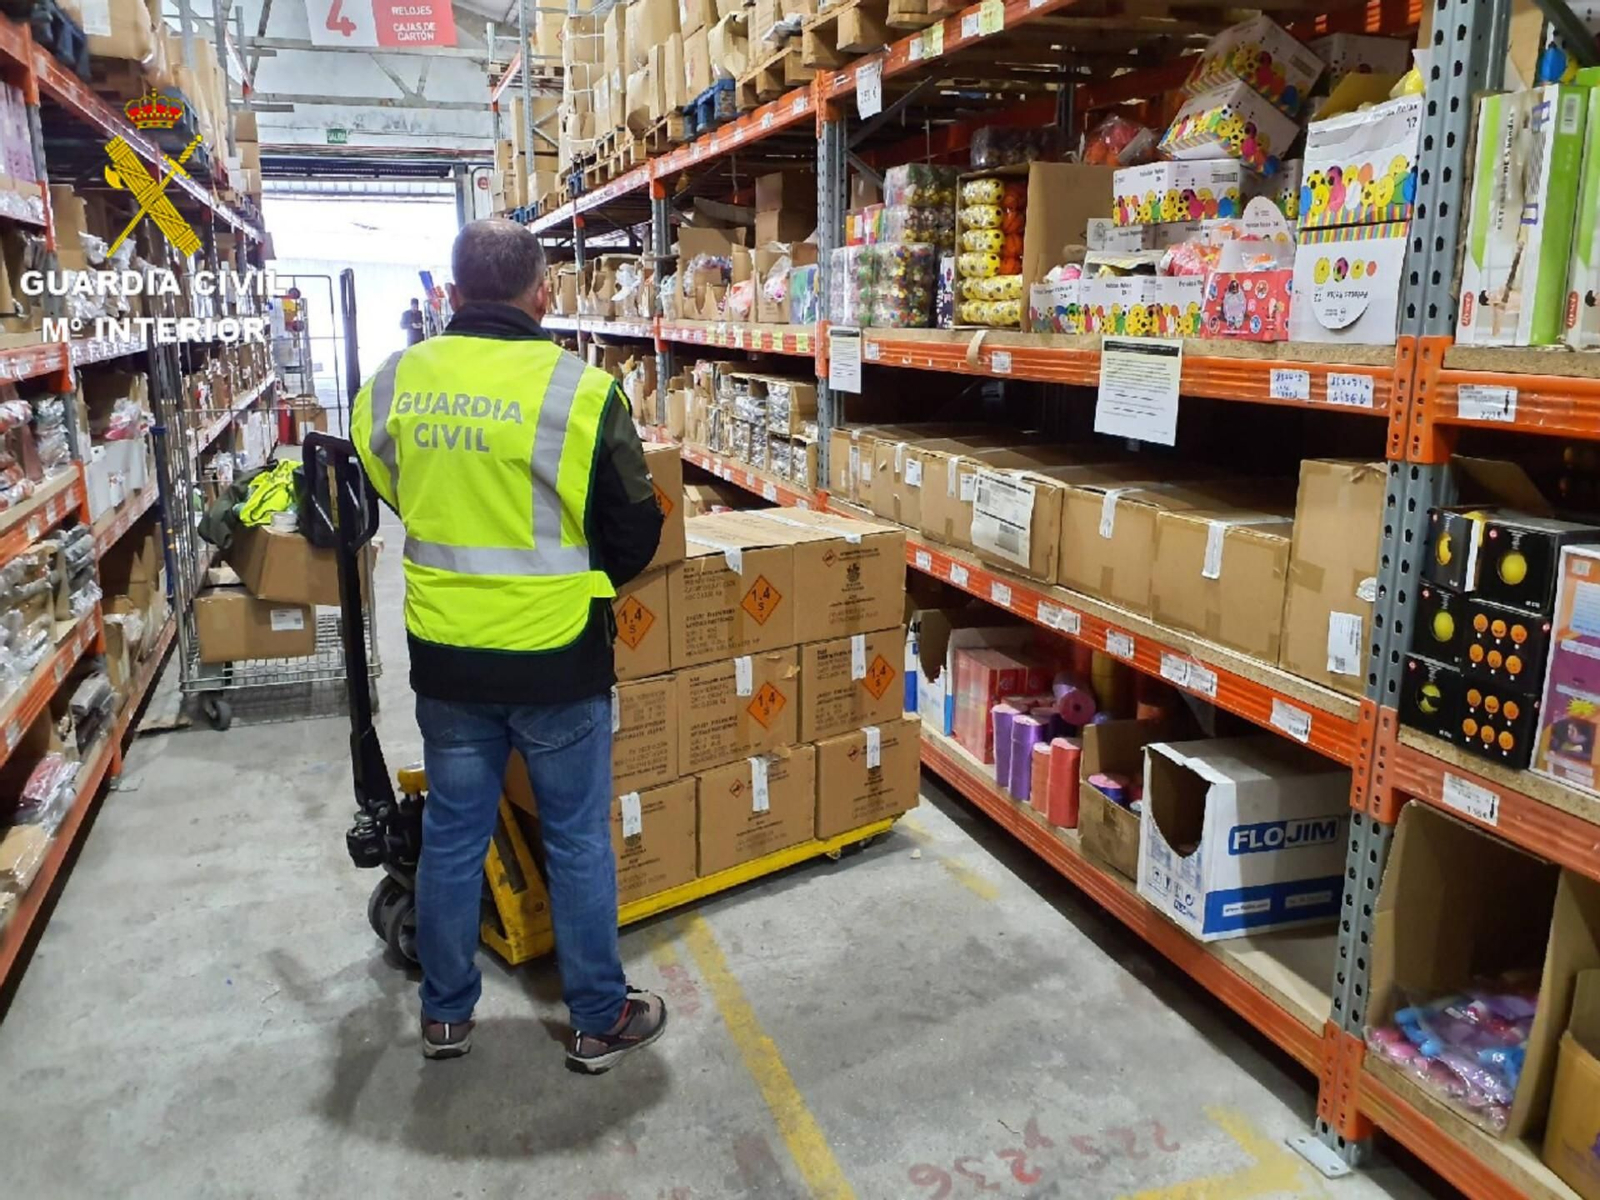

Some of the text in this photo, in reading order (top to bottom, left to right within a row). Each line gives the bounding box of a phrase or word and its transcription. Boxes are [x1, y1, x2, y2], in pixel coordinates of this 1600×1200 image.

[391, 6, 432, 15] RELOJES
[326, 0, 357, 37] 4
[393, 22, 436, 32] CAJAS DE
[397, 31, 434, 41] CARTÓN
[396, 392, 523, 425] GUARDIA
[414, 422, 490, 452] CIVIL
[752, 587, 771, 602] 1.4
[758, 602, 764, 611] S
[621, 607, 642, 624] 1.4
[629, 625, 636, 634] S
[870, 665, 886, 678] 1.4
[875, 679, 881, 687] S
[758, 692, 776, 708] 1.4
[1233, 820, 1337, 850] FLOJIM
